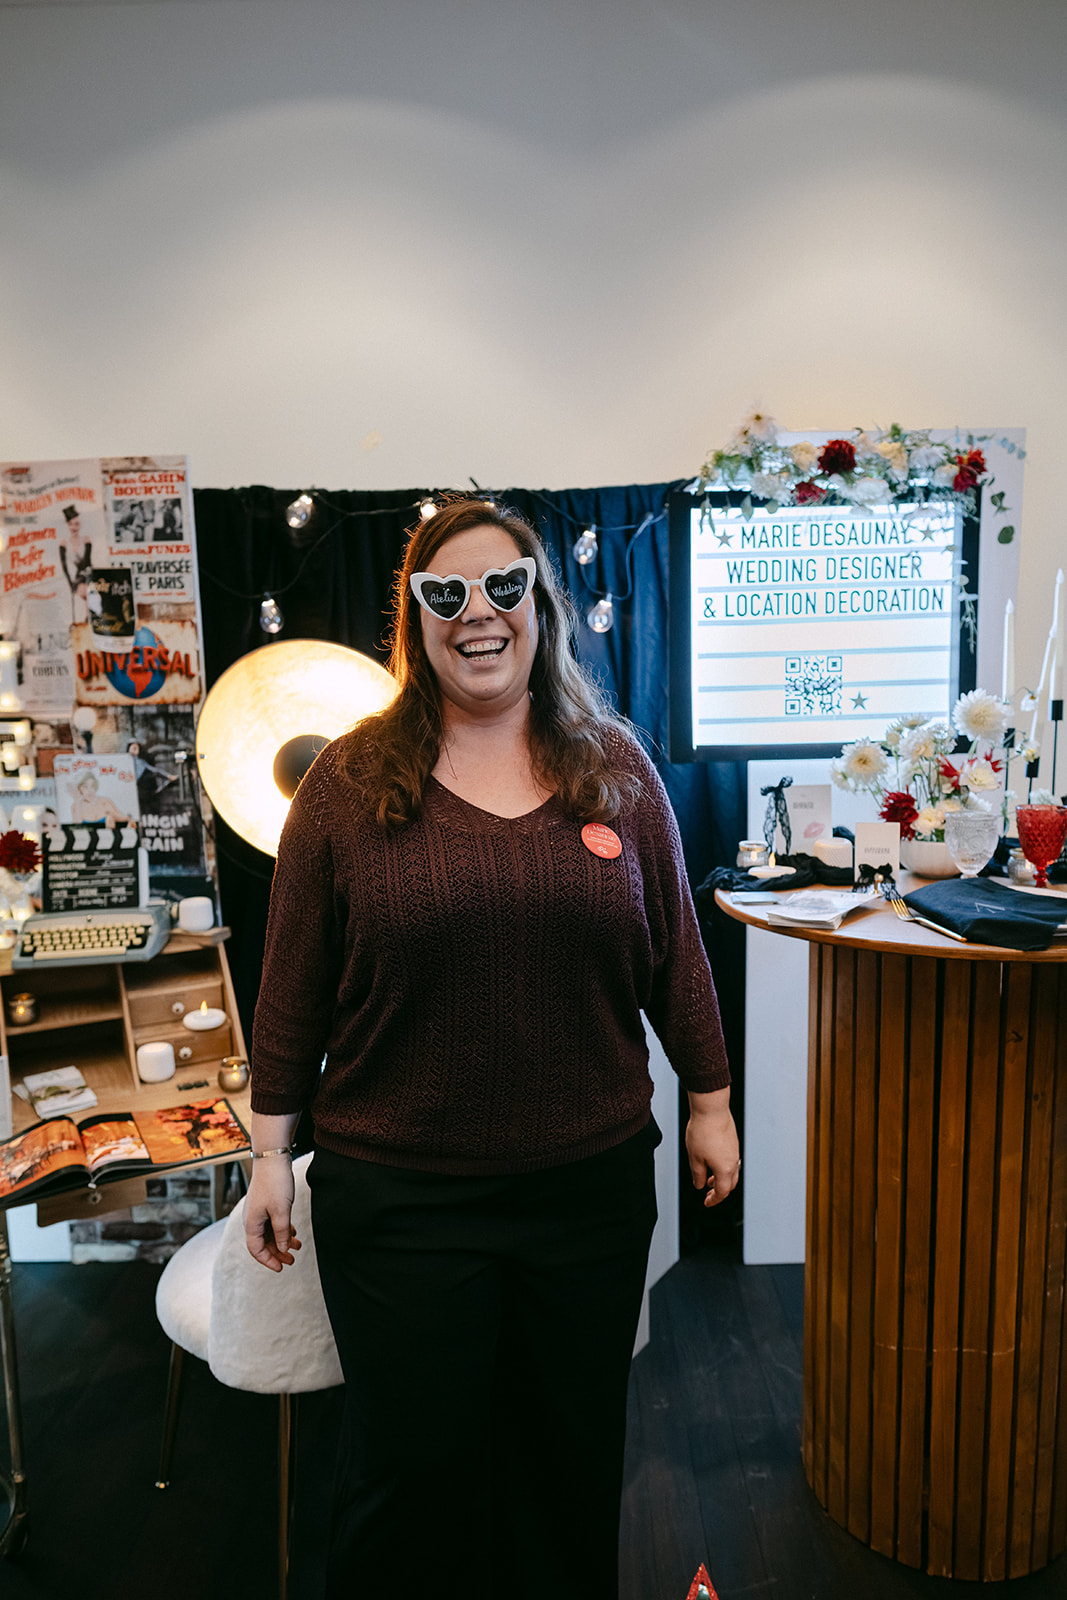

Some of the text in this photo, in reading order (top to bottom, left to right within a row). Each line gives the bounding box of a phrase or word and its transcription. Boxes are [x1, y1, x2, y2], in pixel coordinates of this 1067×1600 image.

[114, 485, 179, 496] BOURVIL
[741, 521, 911, 549] MARIE DESAUNAY
[10, 545, 44, 569] Prefer
[727, 555, 923, 584] WEDDING DESIGNER
[4, 563, 56, 593] Blondes
[149, 575, 185, 589] PARIS
[430, 582, 524, 604] Atelier Wedding
[703, 587, 945, 618] & LOCATION DECORATION
[76, 646, 196, 681] UNIVERSAL
[141, 810, 192, 829] INGIN'
